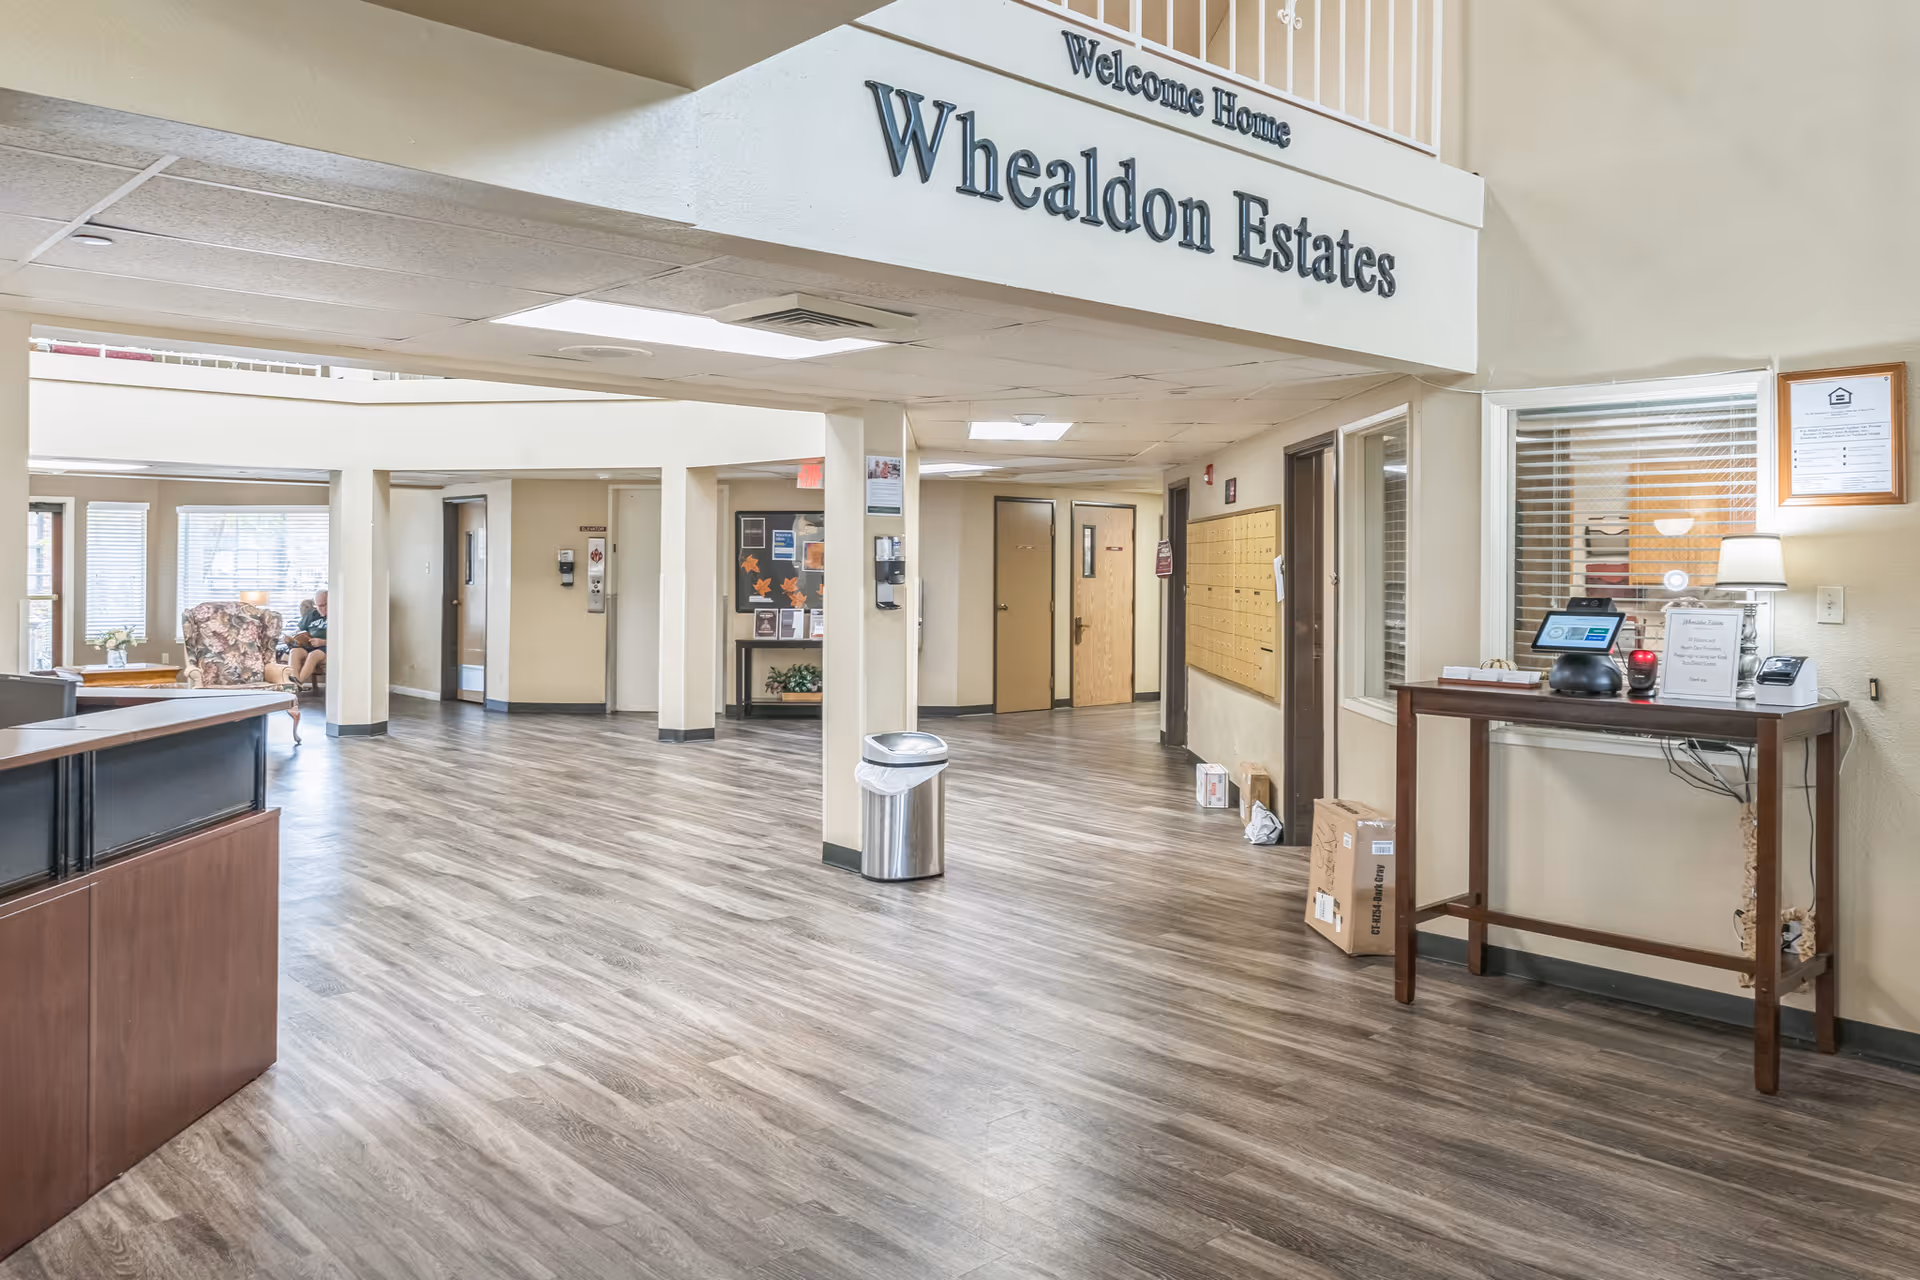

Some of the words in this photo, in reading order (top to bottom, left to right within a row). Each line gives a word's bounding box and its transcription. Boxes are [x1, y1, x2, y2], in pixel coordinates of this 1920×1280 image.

[1061, 30, 1204, 117] Welcome
[1211, 87, 1291, 149] Home
[865, 80, 1215, 254] Whealdon
[1232, 190, 1396, 299] Estates
[1374, 864, 1385, 882] Gray
